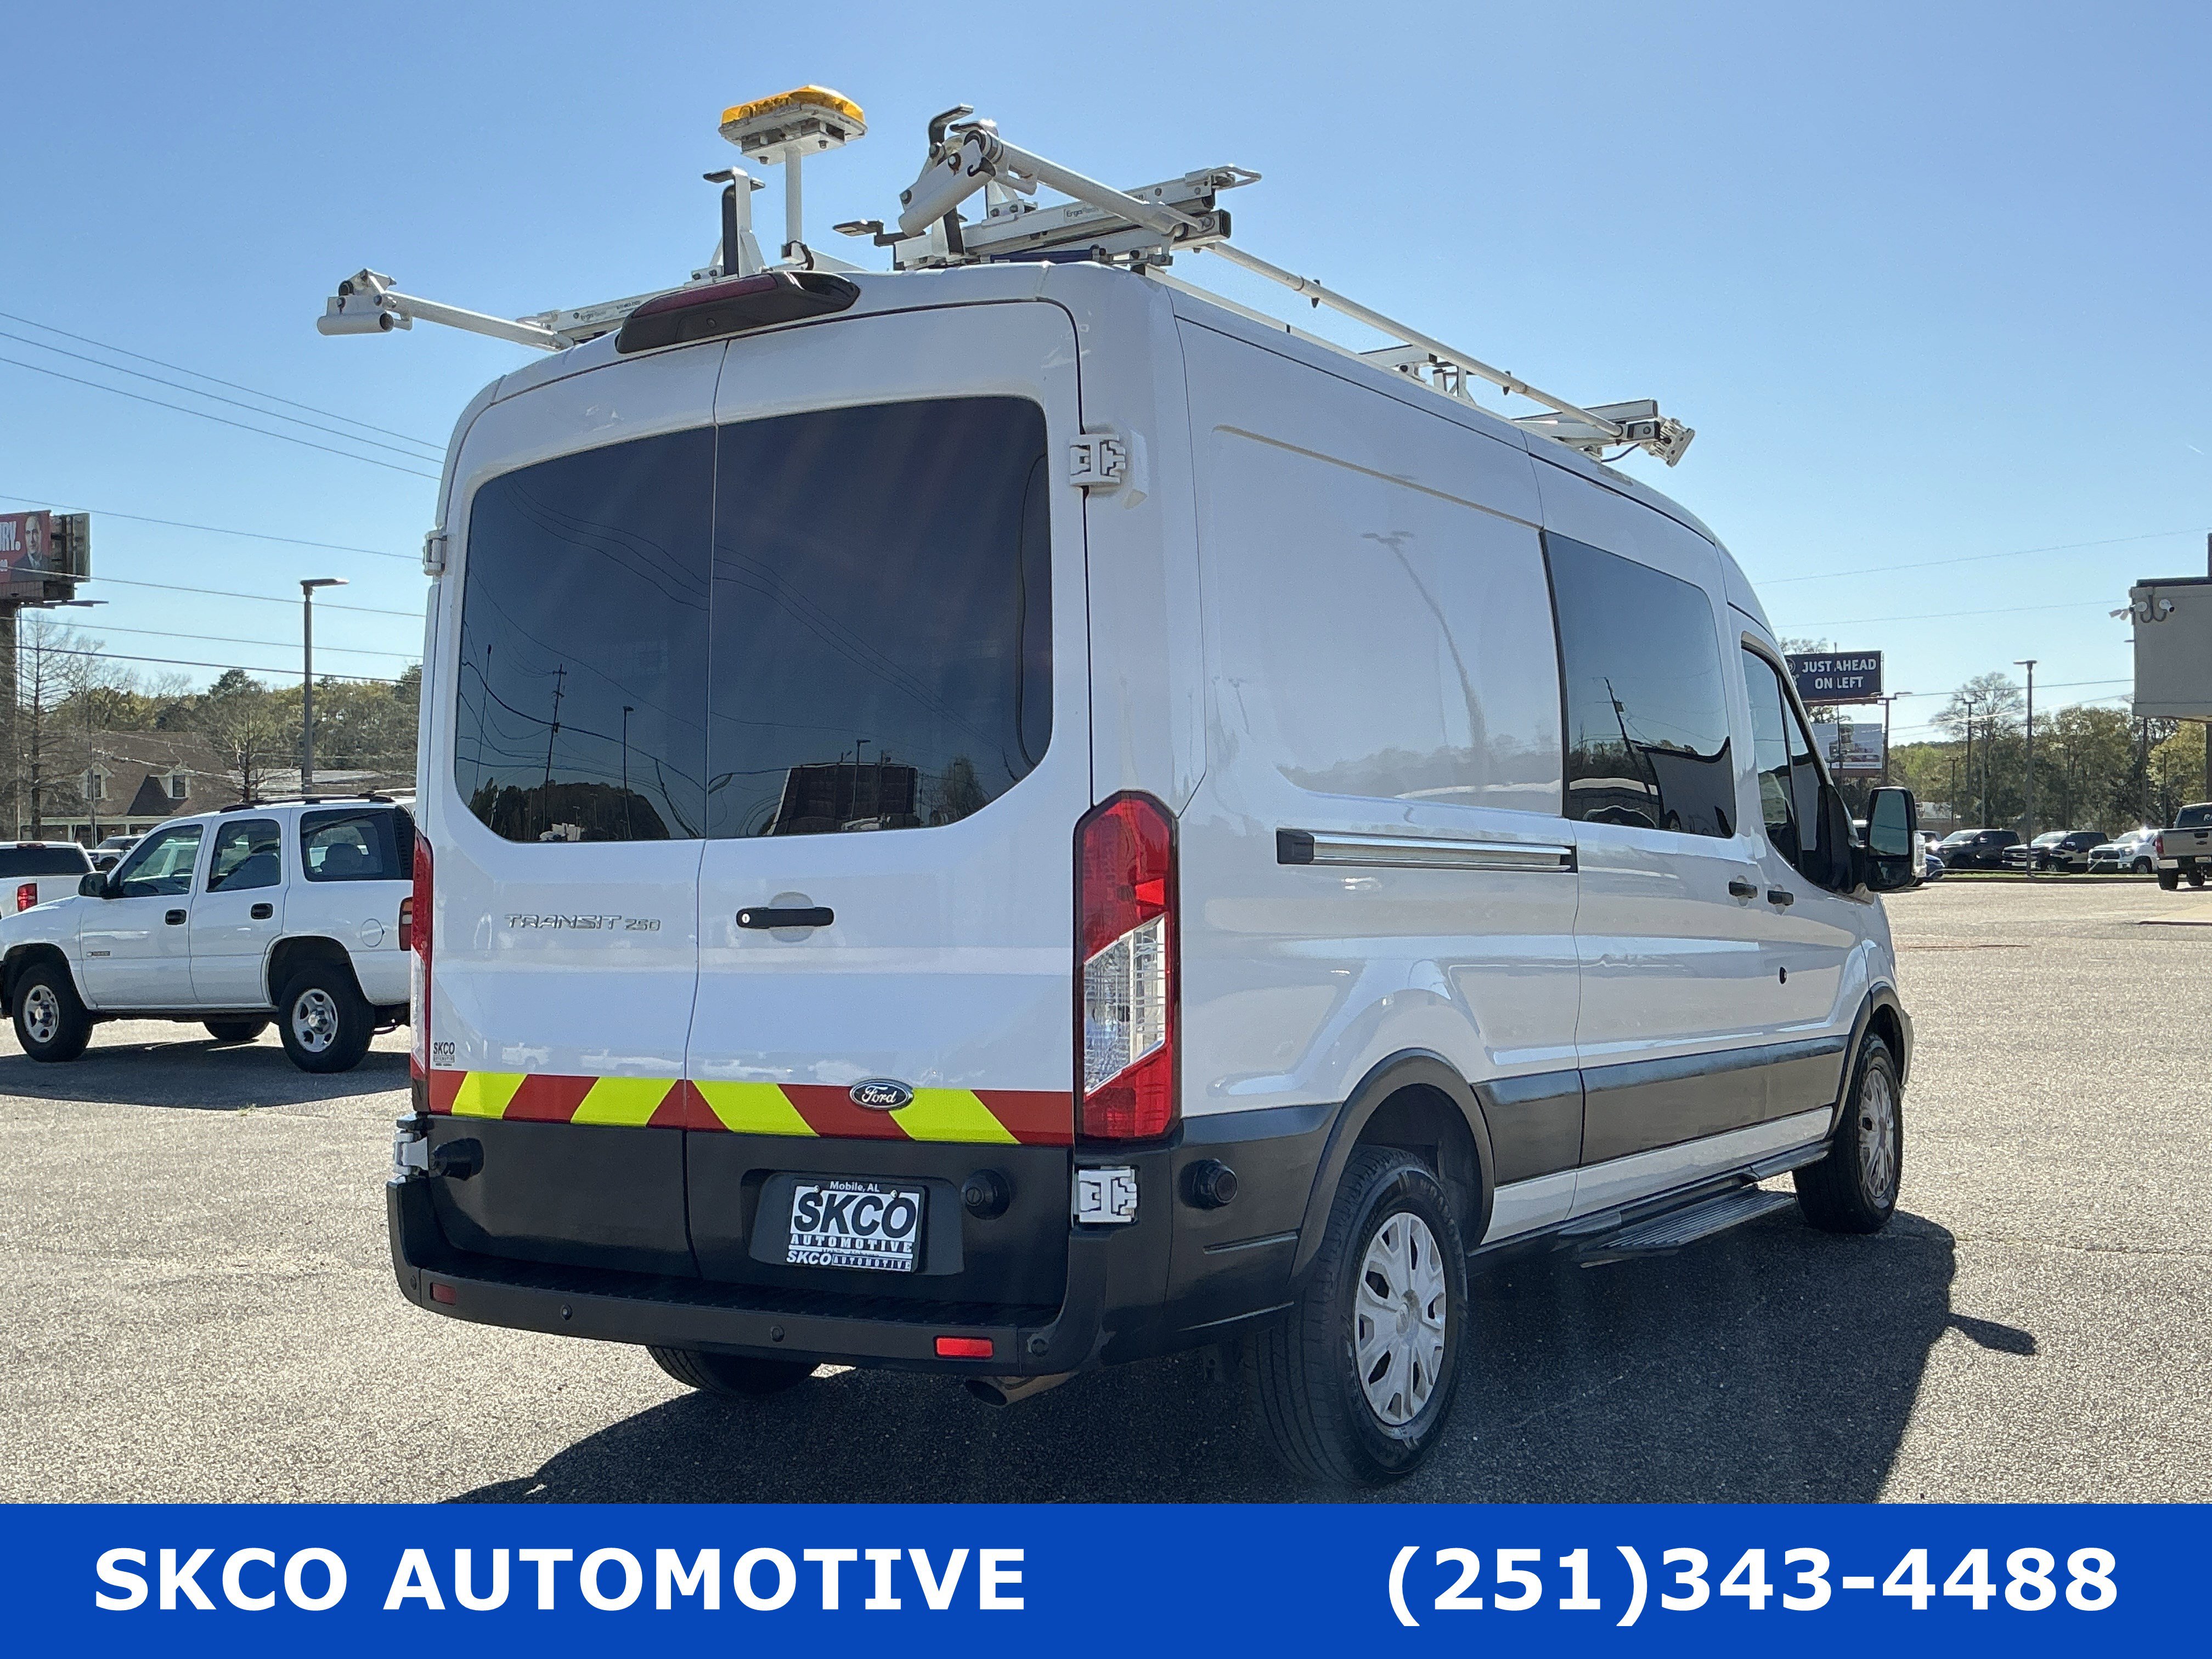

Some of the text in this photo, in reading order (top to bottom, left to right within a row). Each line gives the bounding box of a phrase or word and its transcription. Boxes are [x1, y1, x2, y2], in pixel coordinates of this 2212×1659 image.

[1802, 660, 1832, 673] JUST
[1833, 658, 1877, 673] AHEAD
[1814, 677, 1833, 690] ON
[1837, 676, 1864, 689] LEFT
[504, 914, 662, 932] TRANSIT 250
[433, 1041, 455, 1055] SKCO
[861, 1085, 898, 1103] Ford
[830, 1180, 881, 1193] Mobile, AL
[794, 1190, 916, 1239] SKCO
[790, 1233, 913, 1253] AUTOMOTIVE
[786, 1250, 832, 1266] SKCO
[833, 1255, 911, 1270] AUTOMOTIVE
